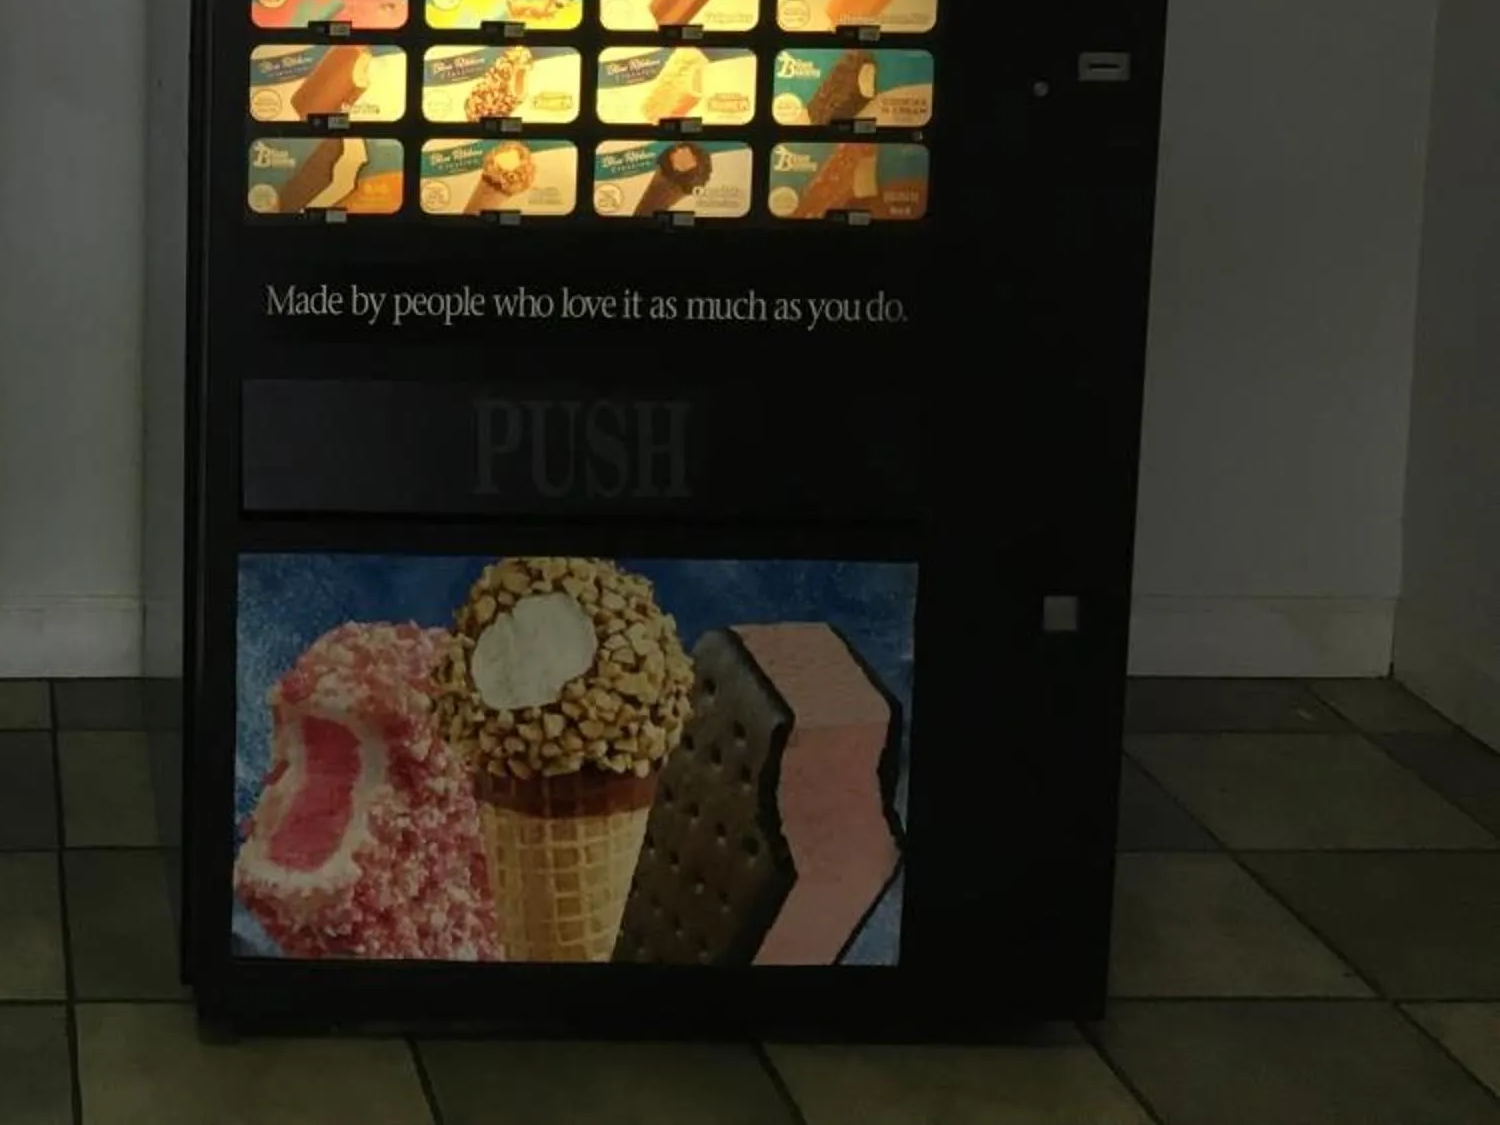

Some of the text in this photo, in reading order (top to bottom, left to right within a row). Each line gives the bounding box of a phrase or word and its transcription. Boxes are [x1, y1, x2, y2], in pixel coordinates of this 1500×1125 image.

[265, 284, 909, 332] Made by people who love it as much as you do.
[471, 397, 693, 499] PUSH
